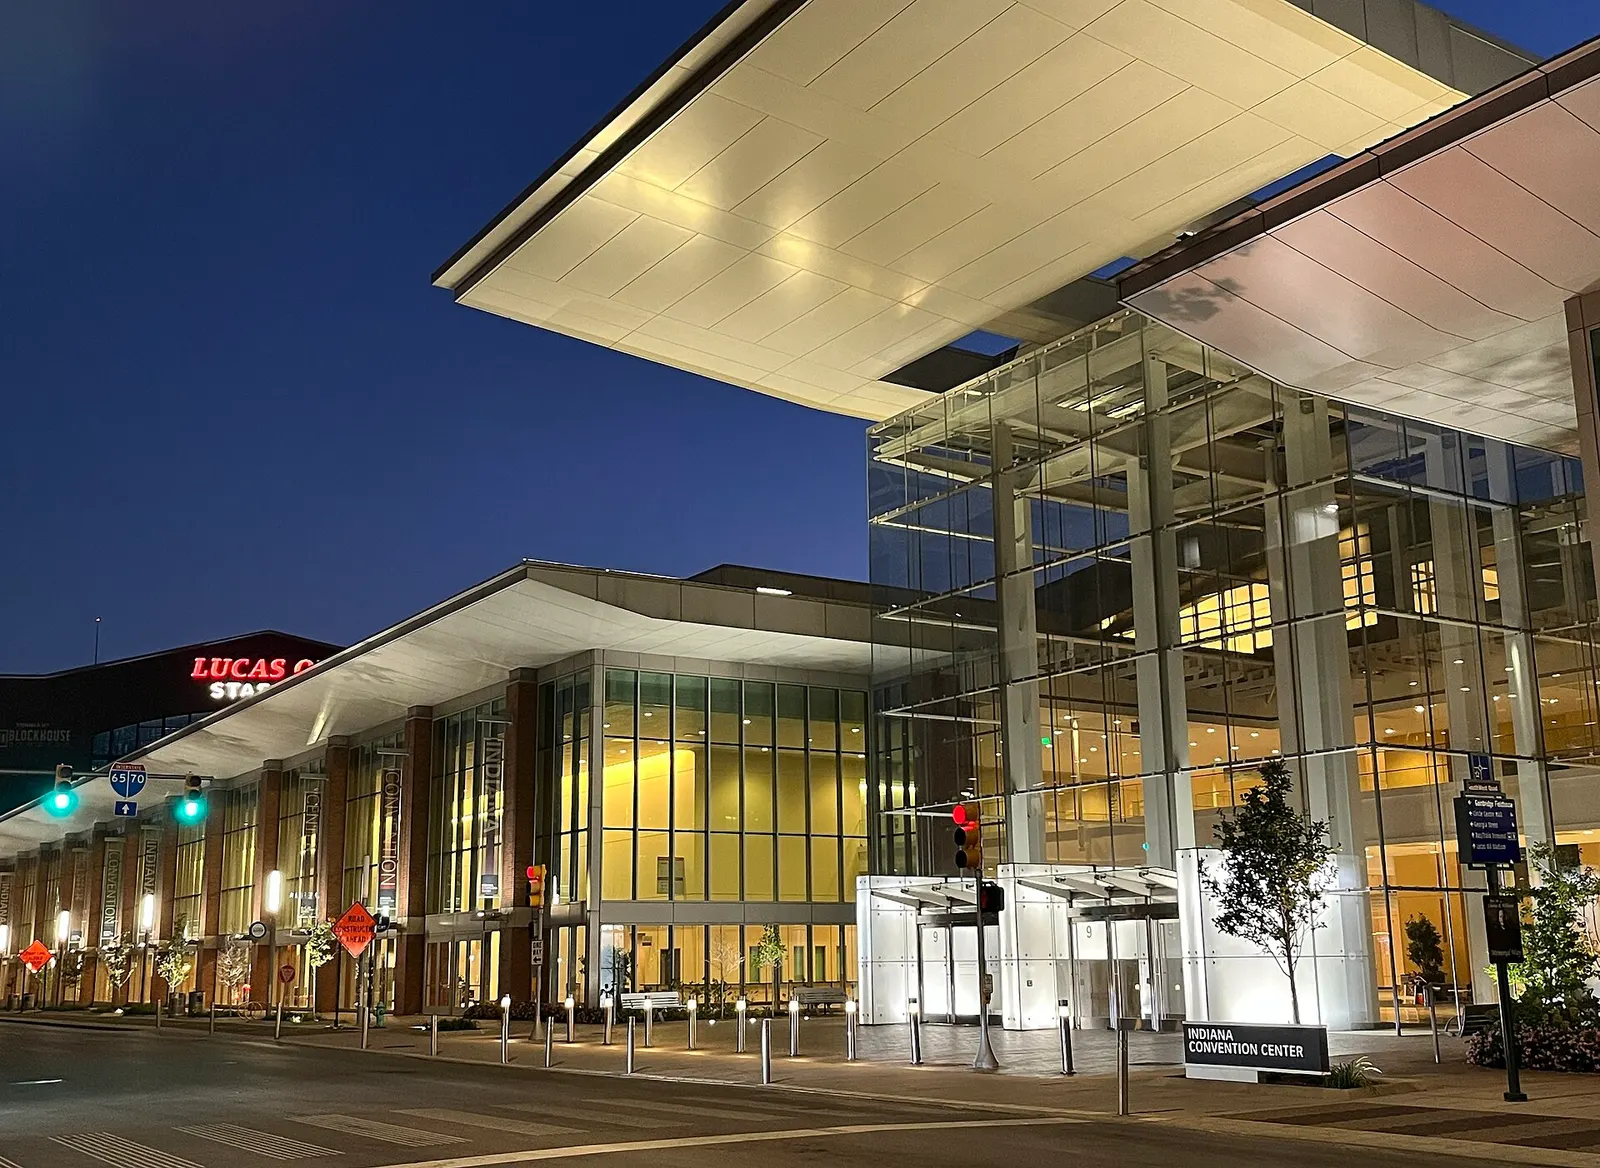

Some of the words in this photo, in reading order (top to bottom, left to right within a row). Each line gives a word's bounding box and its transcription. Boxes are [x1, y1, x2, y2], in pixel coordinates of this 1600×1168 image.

[190, 657, 287, 678] LUCAS
[9, 729, 71, 741] BLOCKHOUSE
[111, 773, 126, 783] 65
[130, 773, 145, 784] 70
[305, 794, 320, 852] CENT
[143, 841, 158, 895] INDIANA
[104, 851, 120, 925] CONVENTION
[0, 883, 10, 925] INDIANA
[933, 931, 939, 943] 9
[1086, 925, 1093, 938] 9
[1187, 1027, 1234, 1042] INDIANA
[1188, 1041, 1259, 1056] CONVENTION
[1260, 1044, 1304, 1058] CENTER
